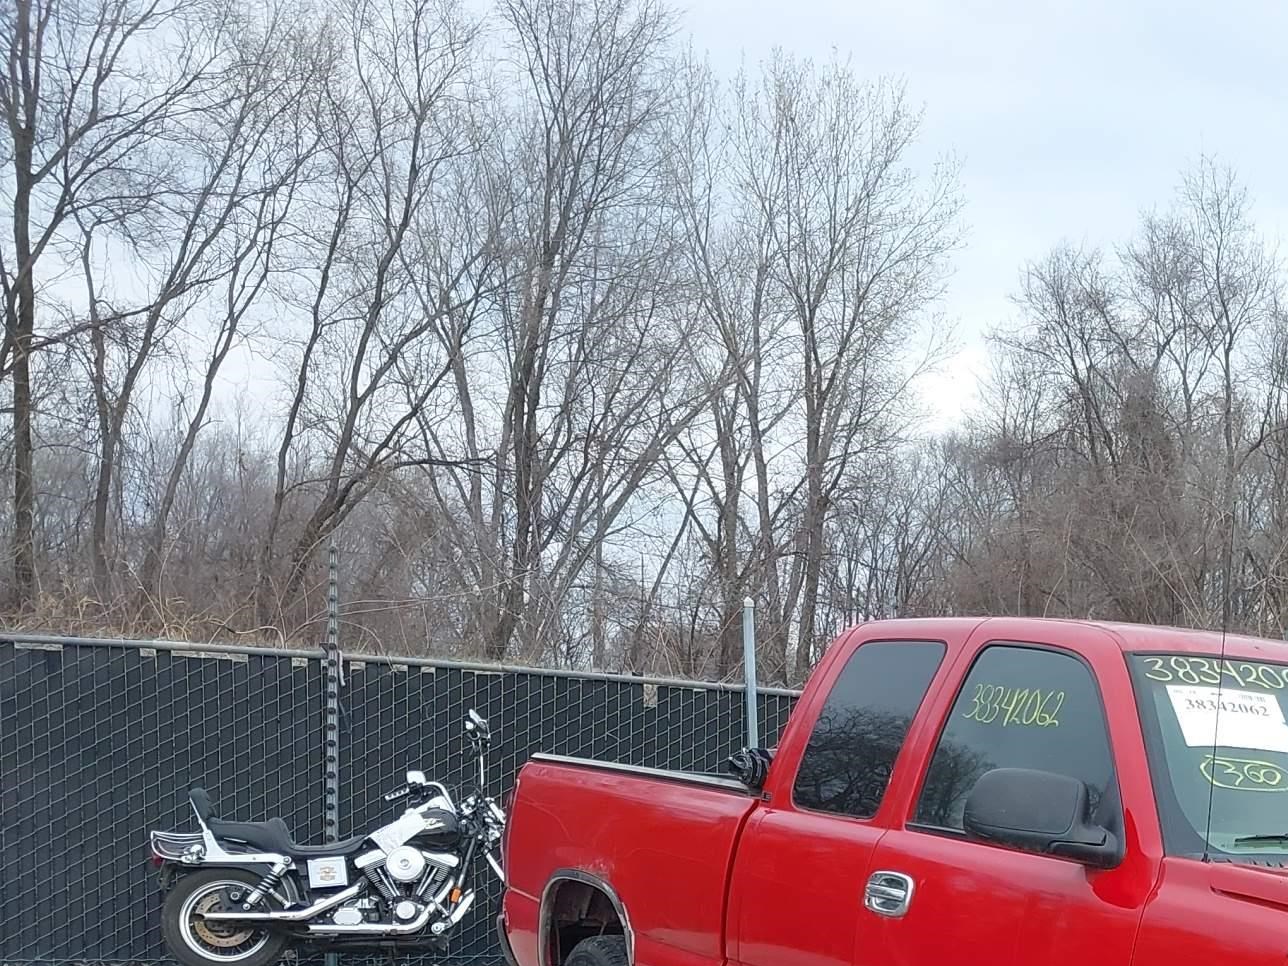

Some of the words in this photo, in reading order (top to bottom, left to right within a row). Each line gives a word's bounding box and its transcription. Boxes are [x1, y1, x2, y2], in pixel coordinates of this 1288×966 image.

[962, 683, 1065, 727] 38342062
[1185, 698, 1270, 717] 38342062
[1210, 760, 1282, 786] 360
